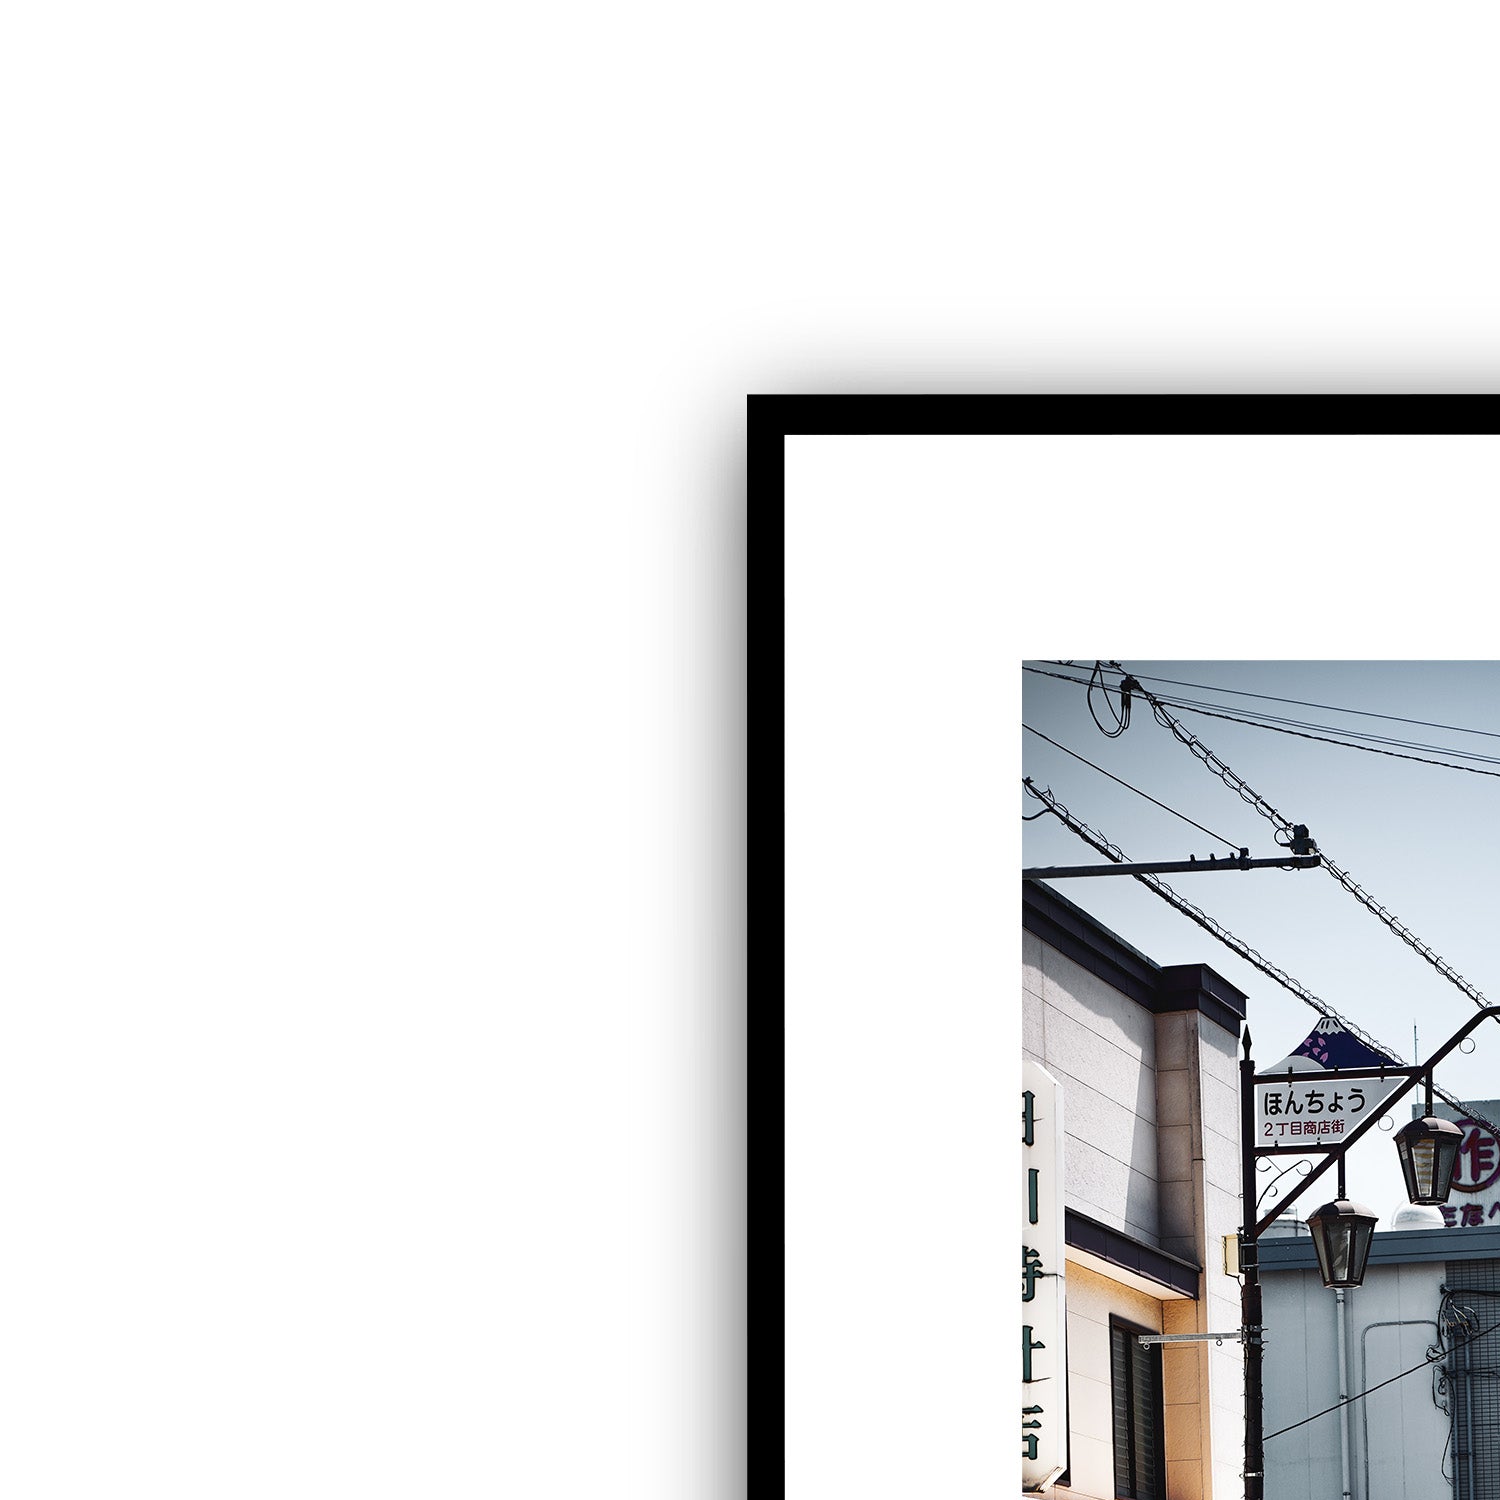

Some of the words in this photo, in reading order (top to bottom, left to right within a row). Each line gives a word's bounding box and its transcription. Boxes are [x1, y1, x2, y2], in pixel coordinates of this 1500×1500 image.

[1264, 1087, 1366, 1116] ほんちょう
[1264, 1119, 1345, 1137] 2丁目商店街
